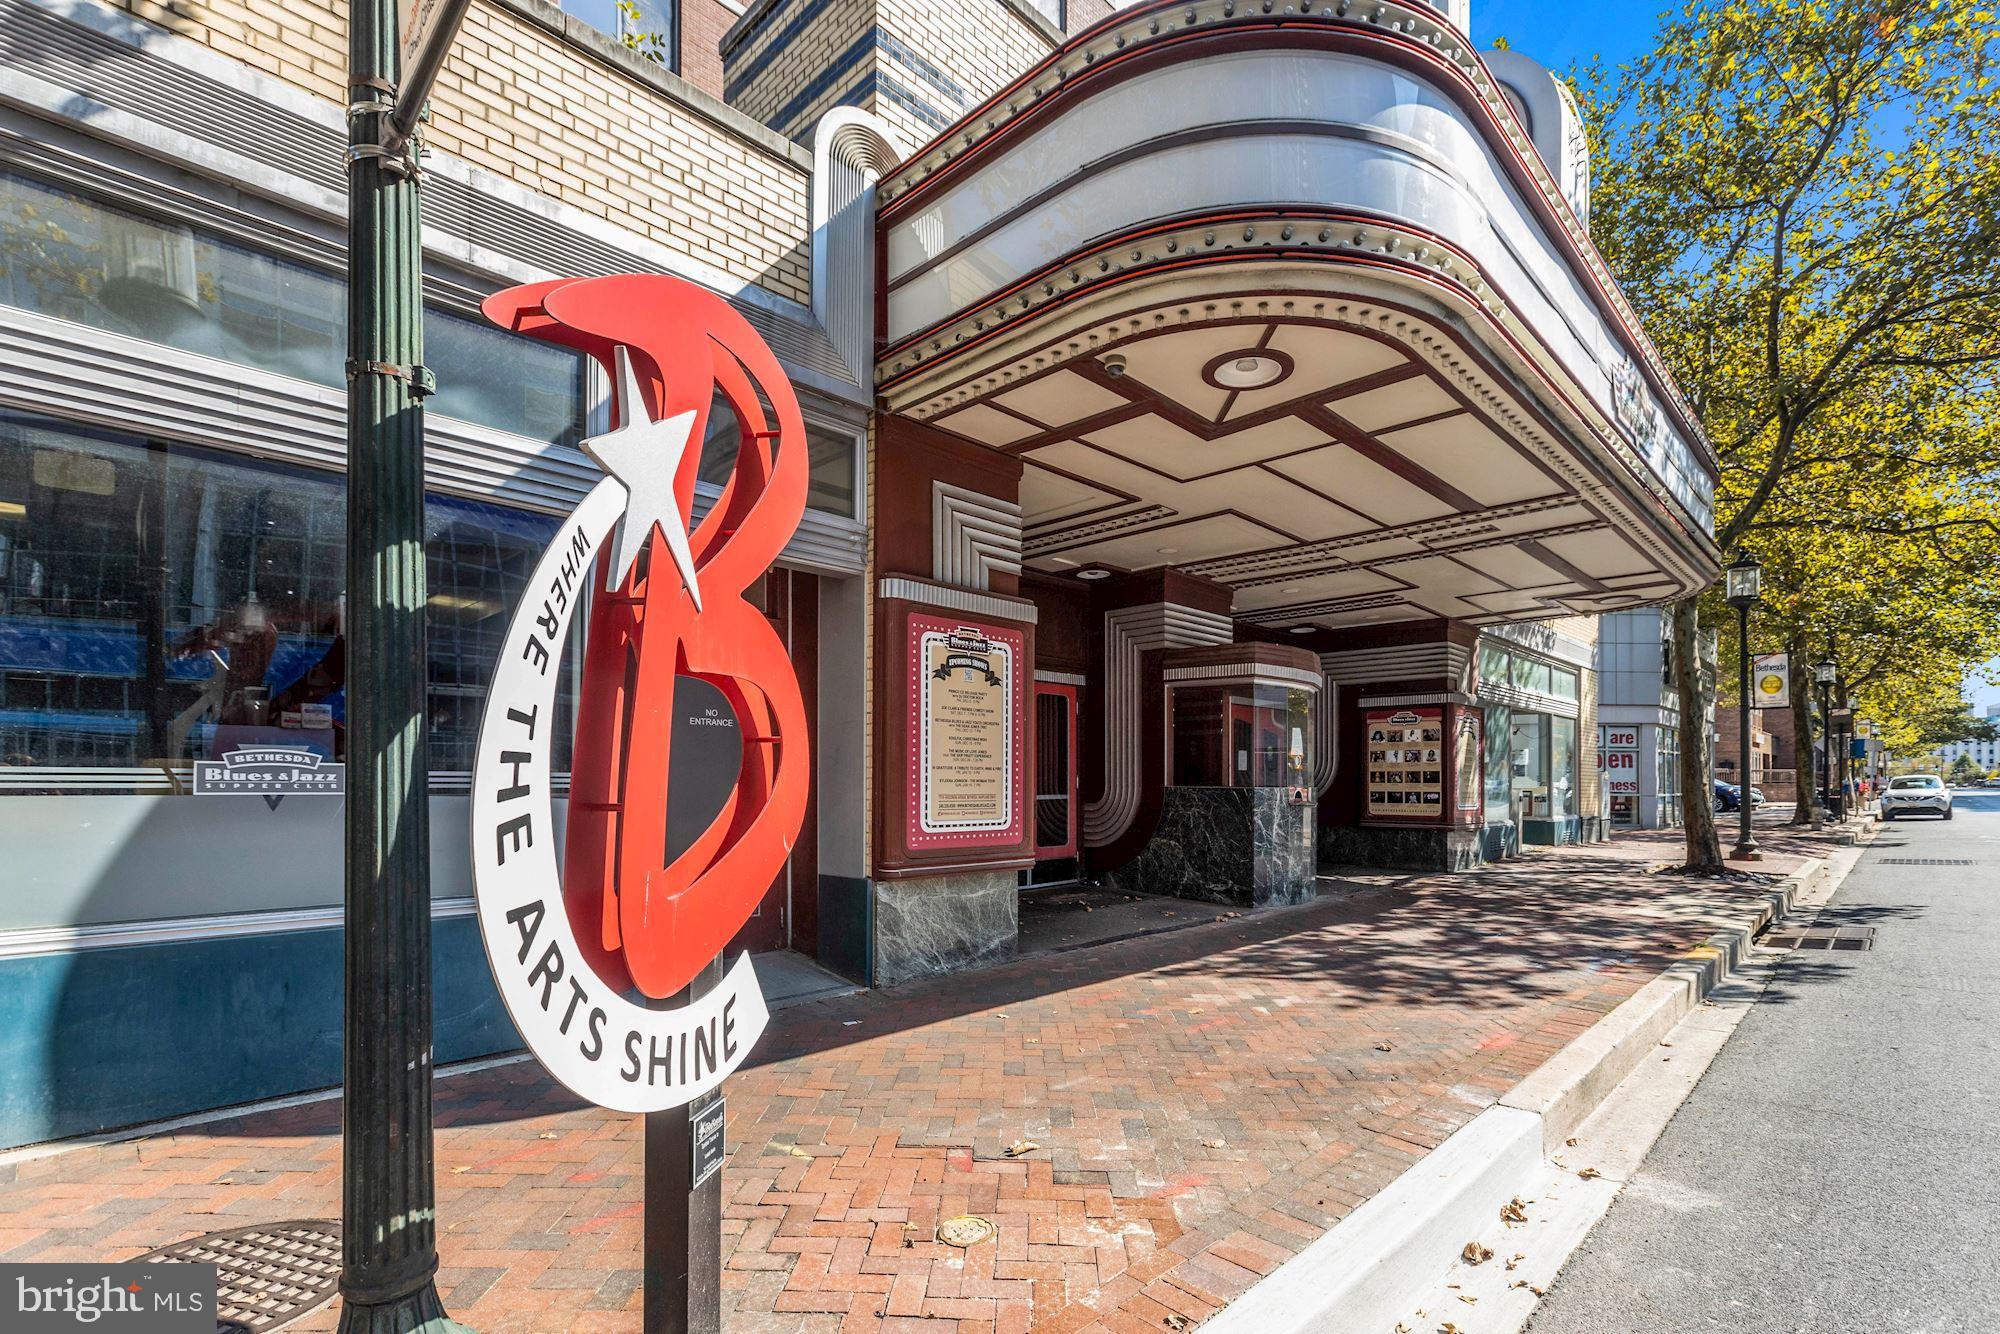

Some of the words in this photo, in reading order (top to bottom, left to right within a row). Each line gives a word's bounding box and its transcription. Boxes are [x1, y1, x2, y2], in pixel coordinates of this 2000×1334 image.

[523, 525, 591, 676] WHERE
[972, 660, 988, 670] SHOWS
[1755, 664, 1786, 672] Bethesda
[690, 718, 733, 726] ENTRANCE
[1610, 734, 1634, 744] are
[234, 754, 311, 764] BETHESDA
[205, 768, 272, 780] Blues
[290, 770, 337, 783] Jazz
[497, 704, 538, 866] THE
[506, 899, 607, 1061] ARTS
[620, 992, 737, 1086] SHINE
